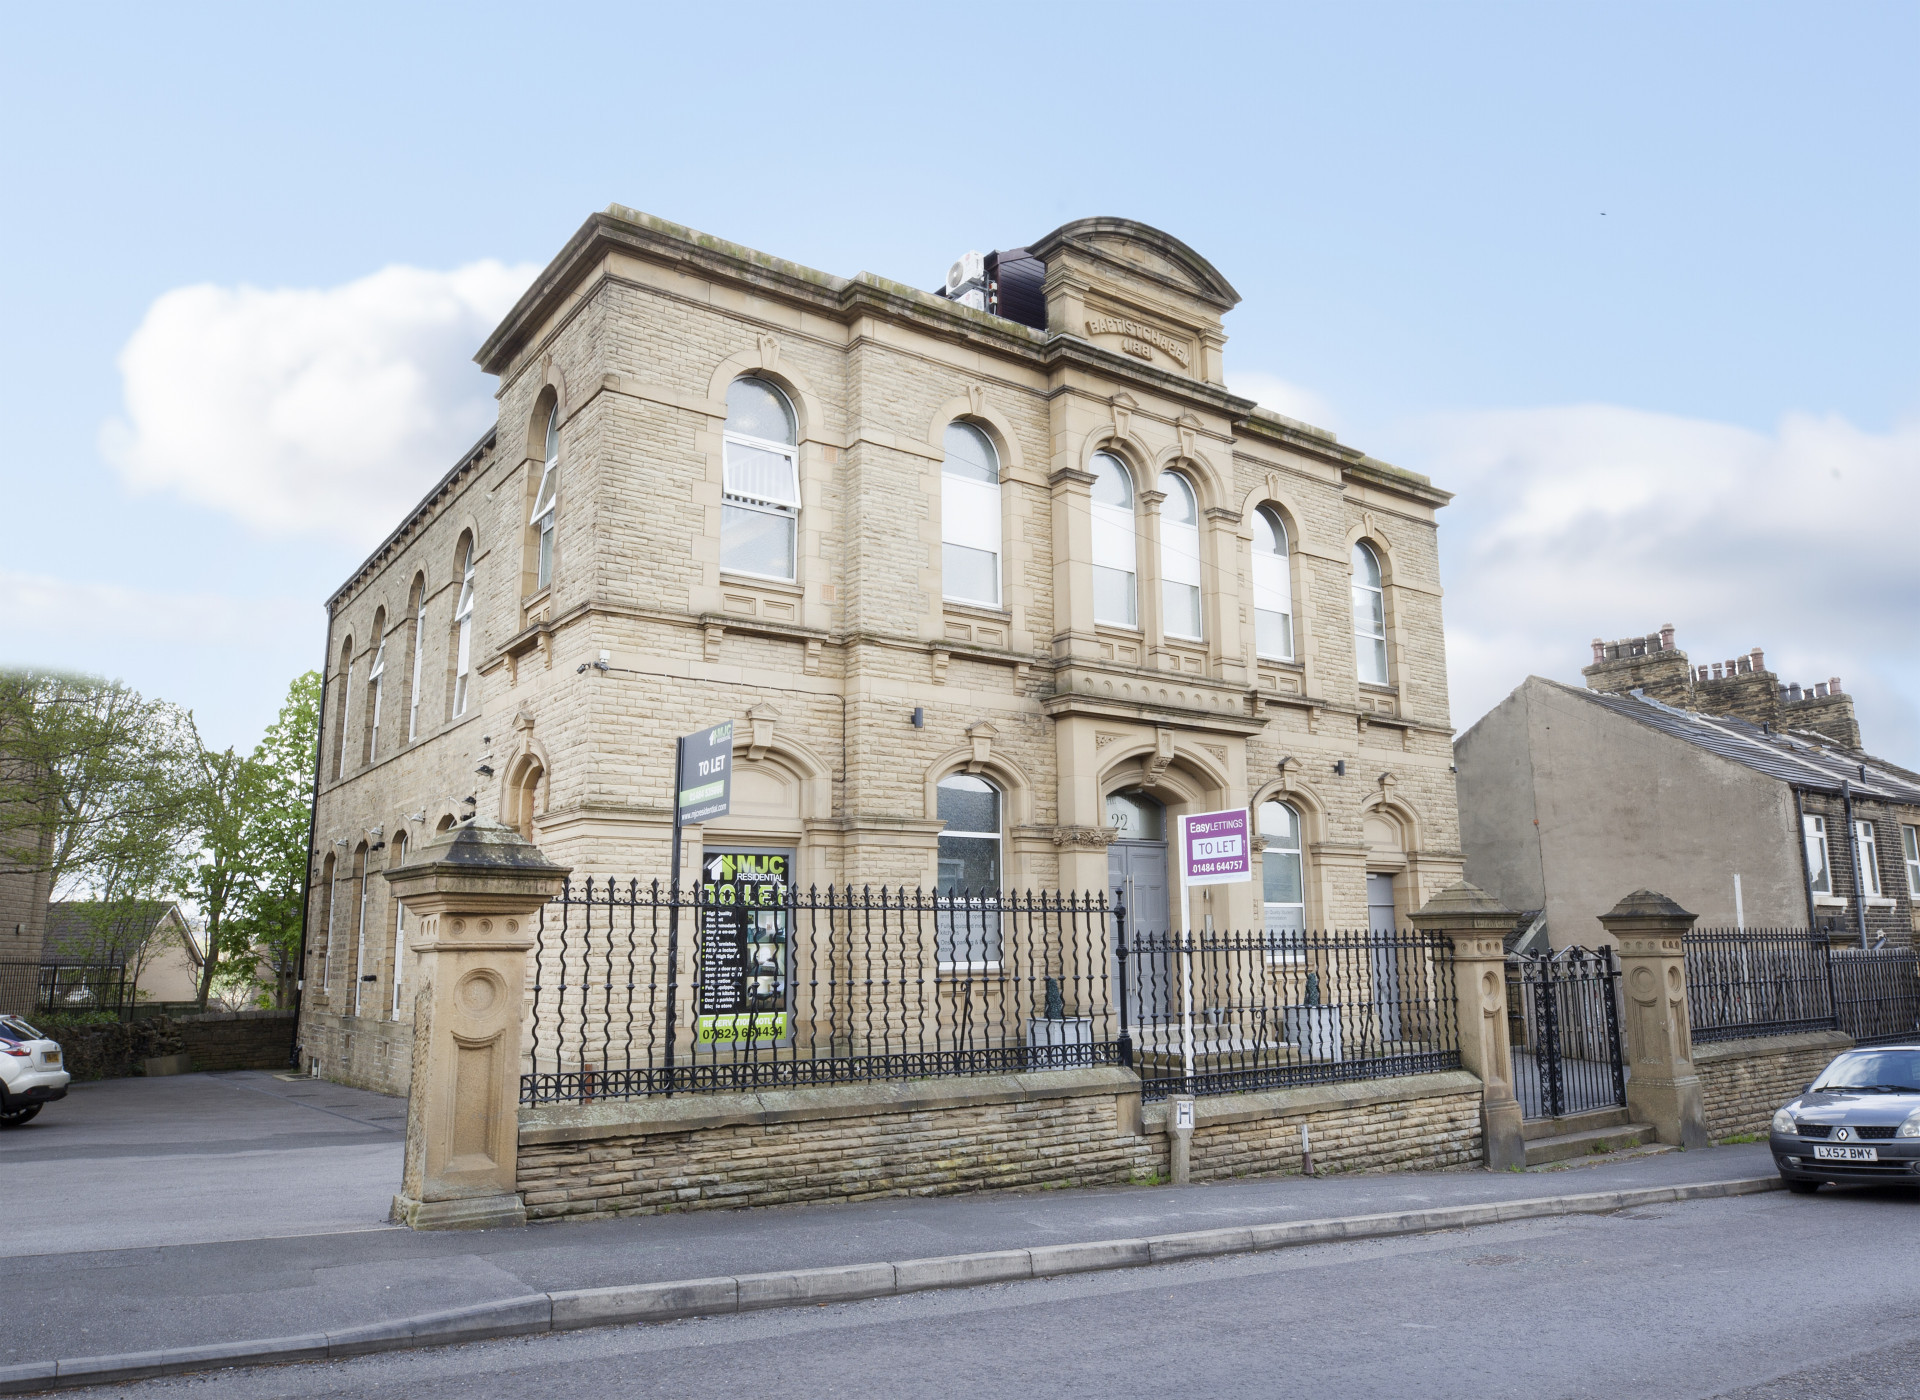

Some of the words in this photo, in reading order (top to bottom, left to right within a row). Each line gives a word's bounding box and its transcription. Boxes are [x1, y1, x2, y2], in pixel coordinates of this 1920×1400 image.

[1086, 318, 1141, 339] BAPTIST
[699, 760, 710, 776] TO
[711, 755, 725, 773] LET
[1198, 843, 1213, 855] TO
[1216, 840, 1236, 853] LET
[737, 855, 784, 874] MJC
[1192, 862, 1215, 873] 01484
[1216, 860, 1243, 871] 644757
[737, 873, 784, 881] RESIDENTIAL
[704, 884, 736, 905] TO
[755, 1017, 783, 1025] HOTLNE
[1179, 1102, 1191, 1124] H
[1818, 1147, 1847, 1158] LX52
[1849, 1148, 1871, 1159] BMY
